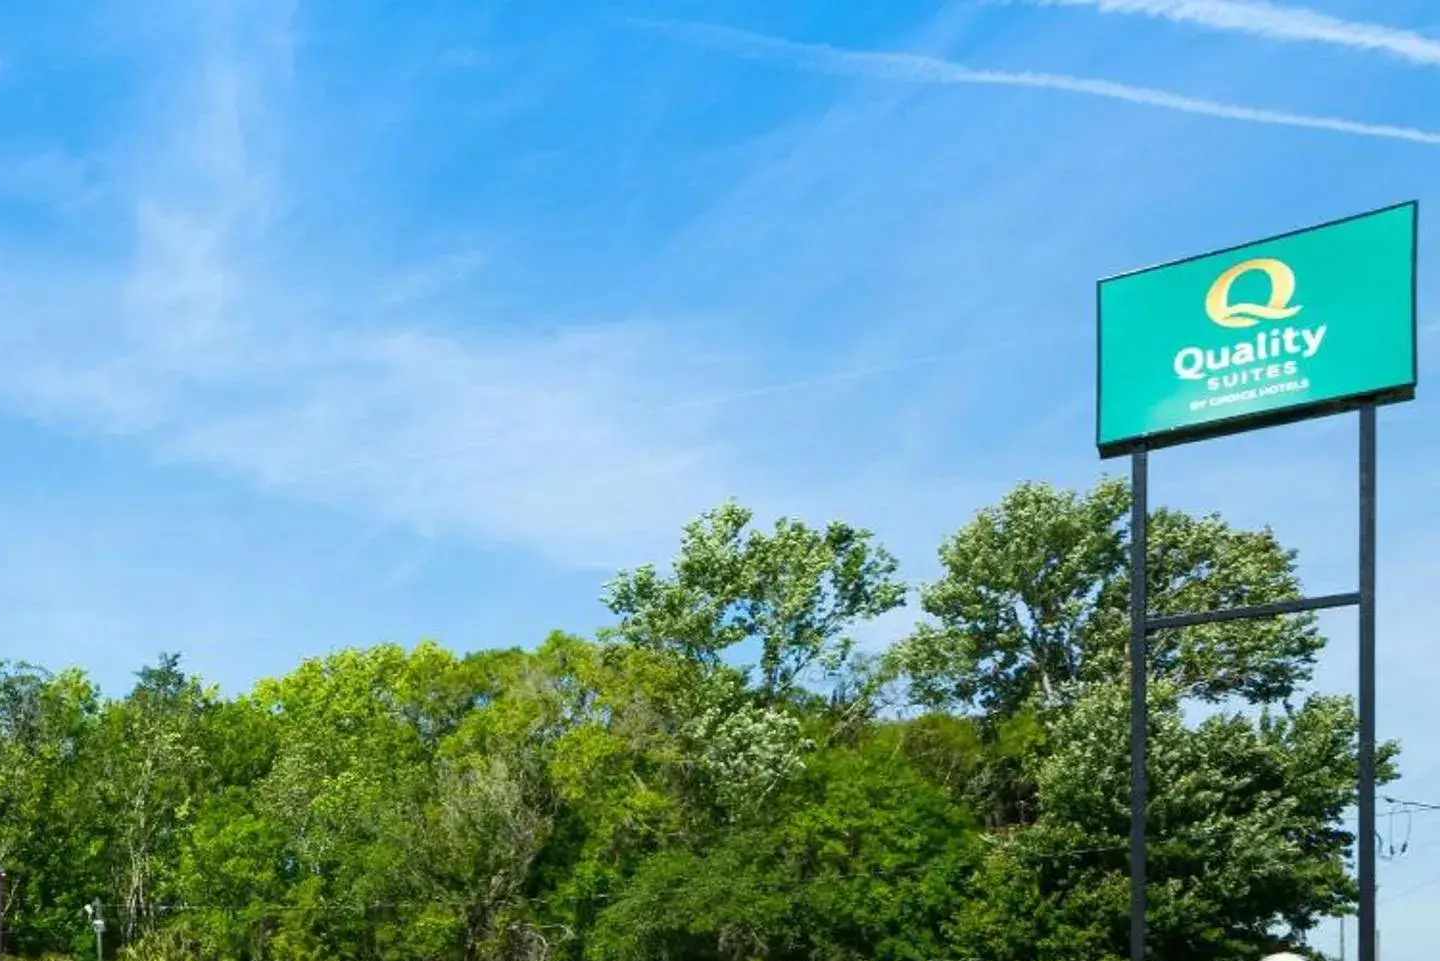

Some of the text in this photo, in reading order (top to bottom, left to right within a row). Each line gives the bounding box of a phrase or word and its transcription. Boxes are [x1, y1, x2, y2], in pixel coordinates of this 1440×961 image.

[1205, 257, 1303, 328] Q
[1173, 324, 1327, 380] Quality
[1189, 398, 1206, 411] BY
[1259, 378, 1309, 397] HOTELS
[1207, 360, 1297, 391] SUITES
